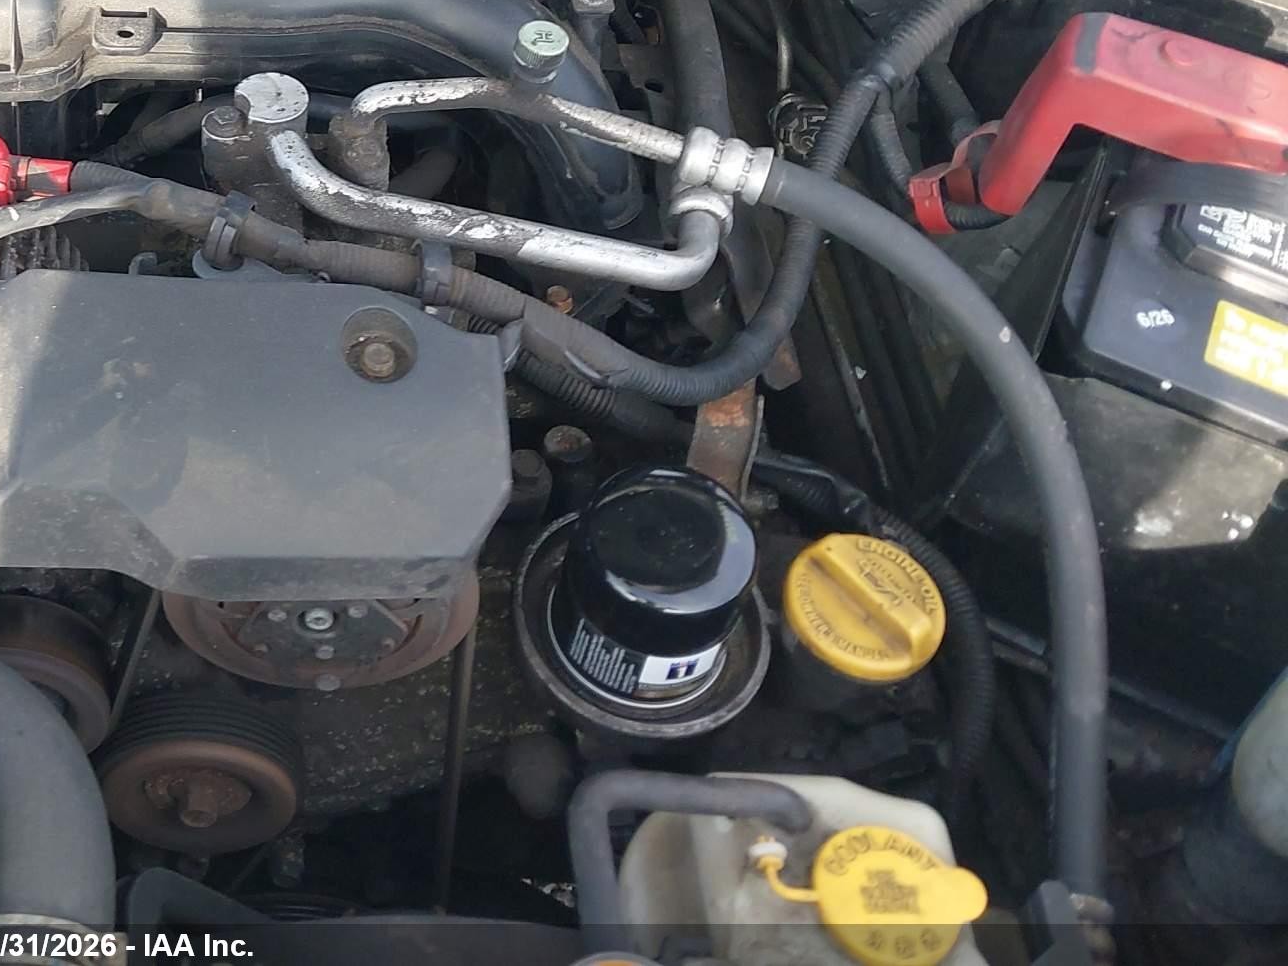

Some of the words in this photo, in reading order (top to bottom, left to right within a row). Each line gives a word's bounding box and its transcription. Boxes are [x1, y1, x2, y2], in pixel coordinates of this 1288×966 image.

[1135, 308, 1176, 328] 6/26
[856, 538, 923, 580] ENGINE
[921, 583, 938, 614] OIL
